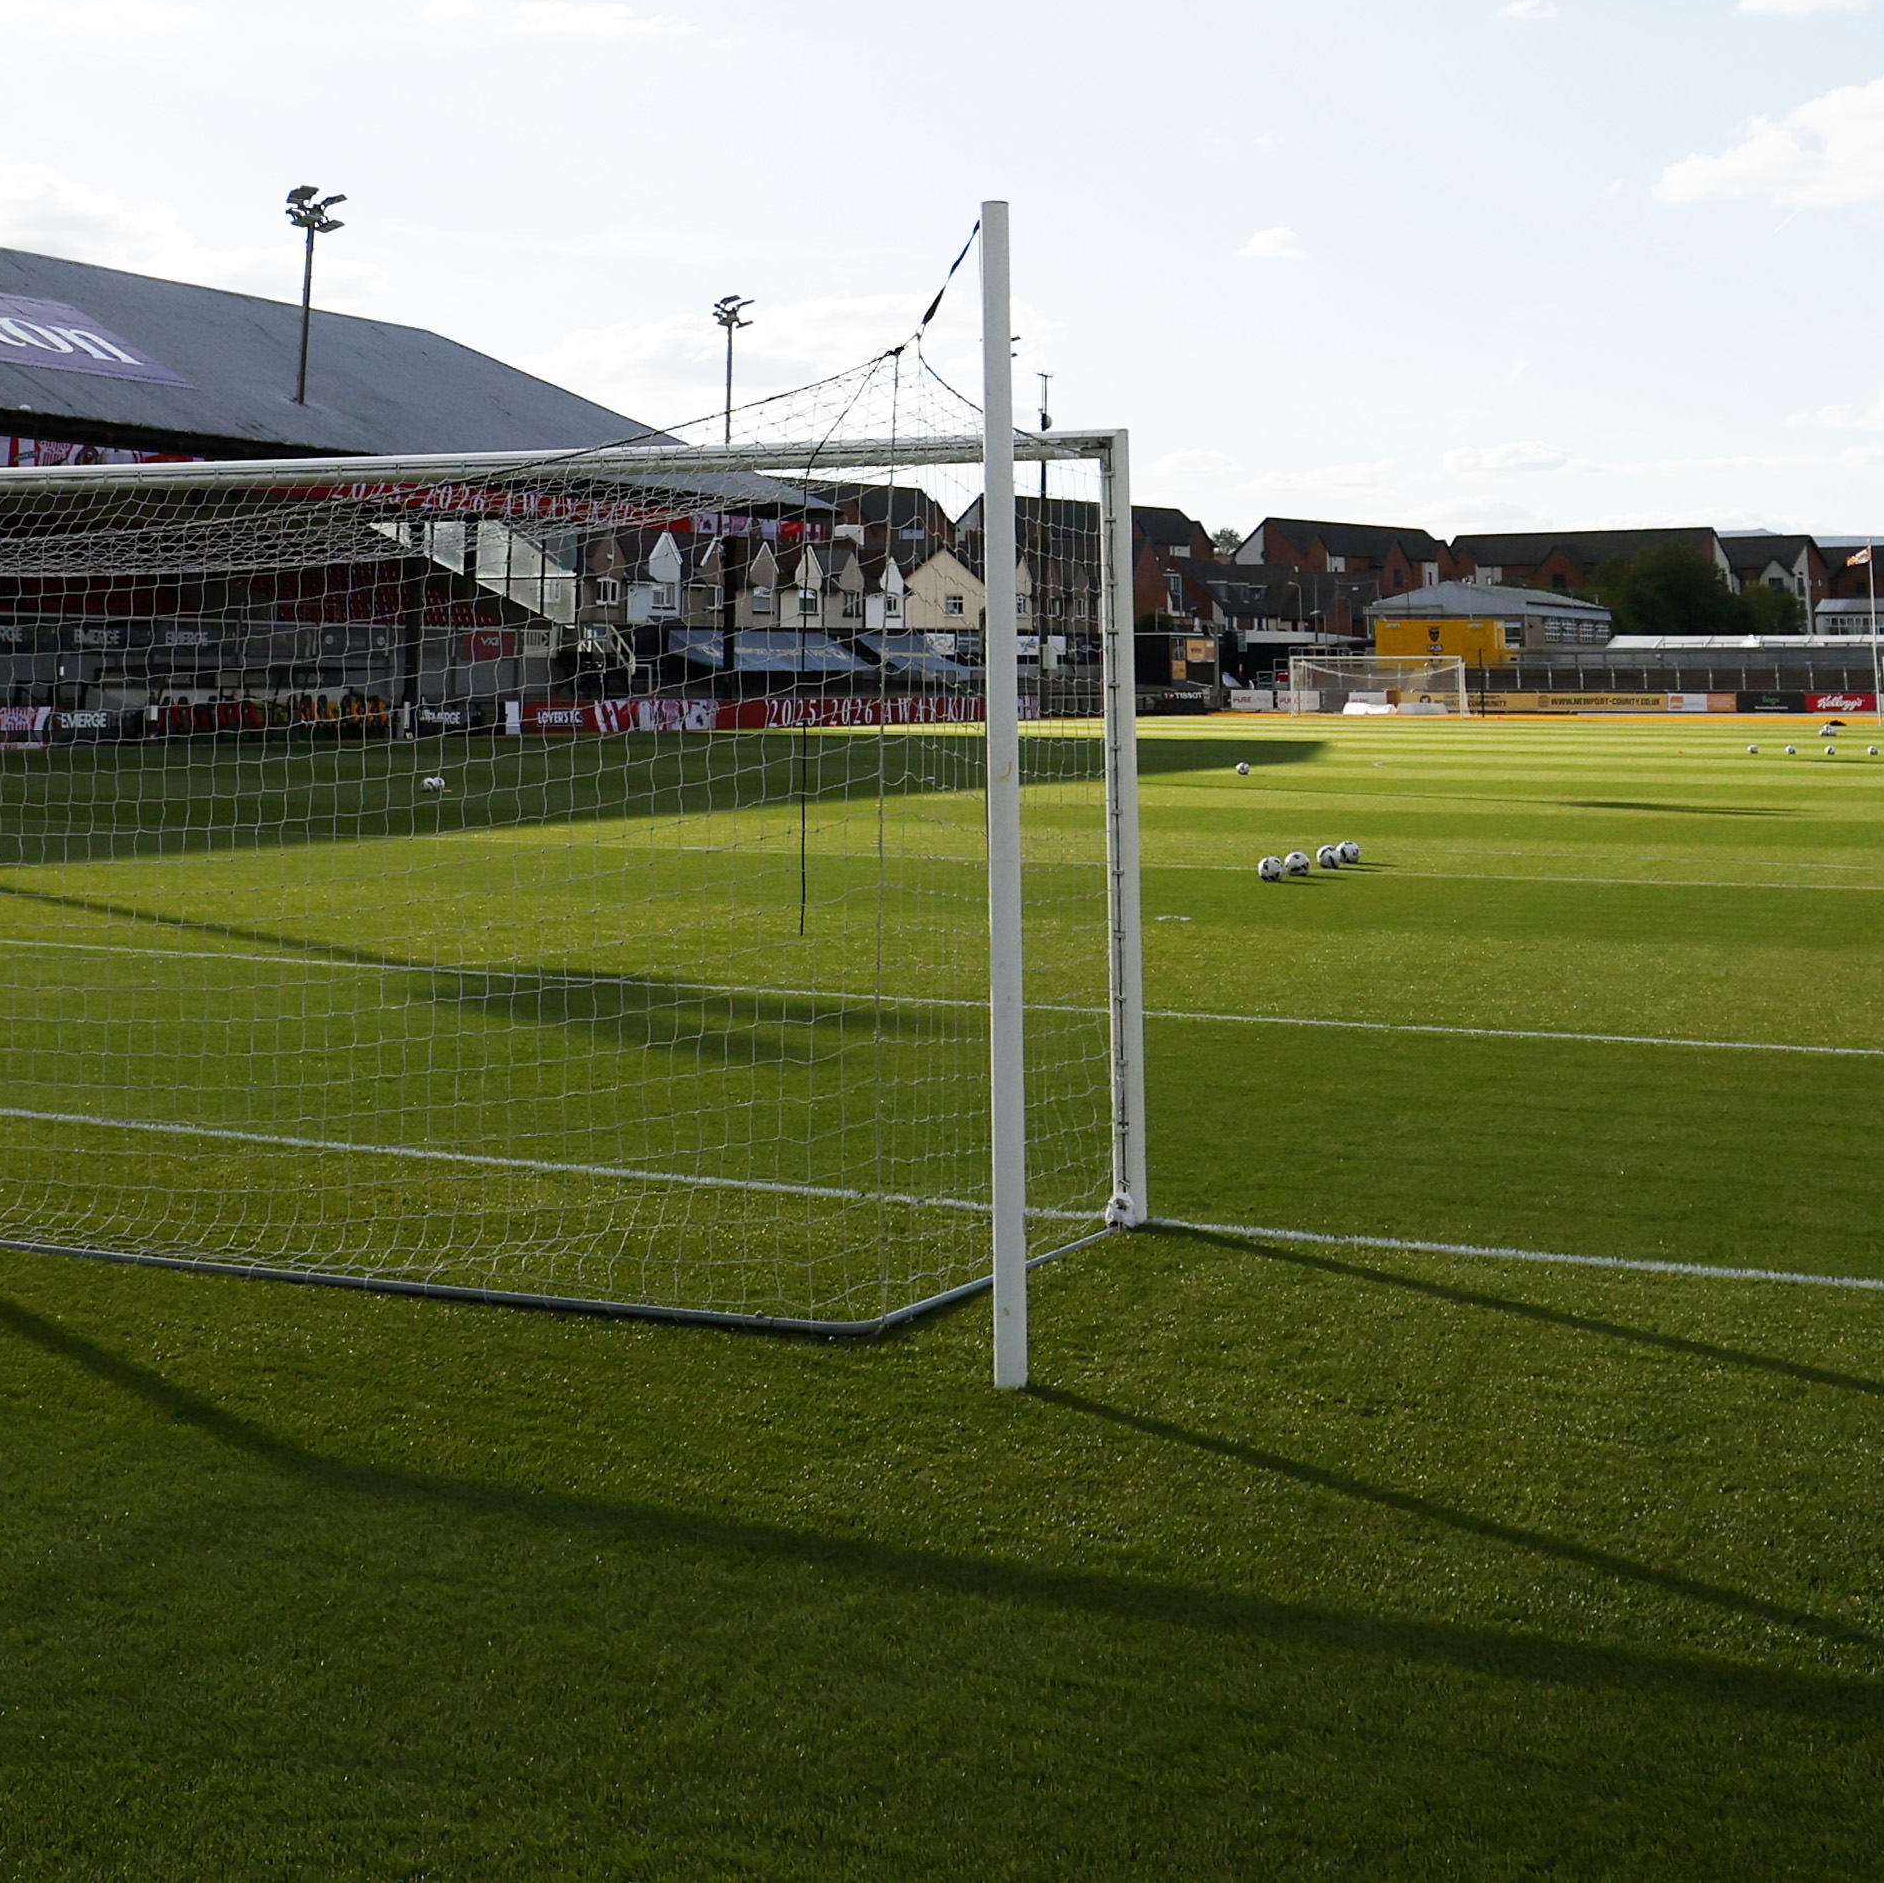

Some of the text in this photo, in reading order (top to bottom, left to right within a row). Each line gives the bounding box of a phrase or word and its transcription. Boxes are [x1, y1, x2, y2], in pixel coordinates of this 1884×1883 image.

[74, 627, 121, 645] EMERGE
[165, 629, 210, 646] EMERGE
[1176, 692, 1203, 700] TISSOT
[1817, 694, 1867, 711] Kellogg's
[883, 697, 938, 725] AWAY
[946, 696, 979, 722] KIT
[60, 712, 107, 729] EMERGE
